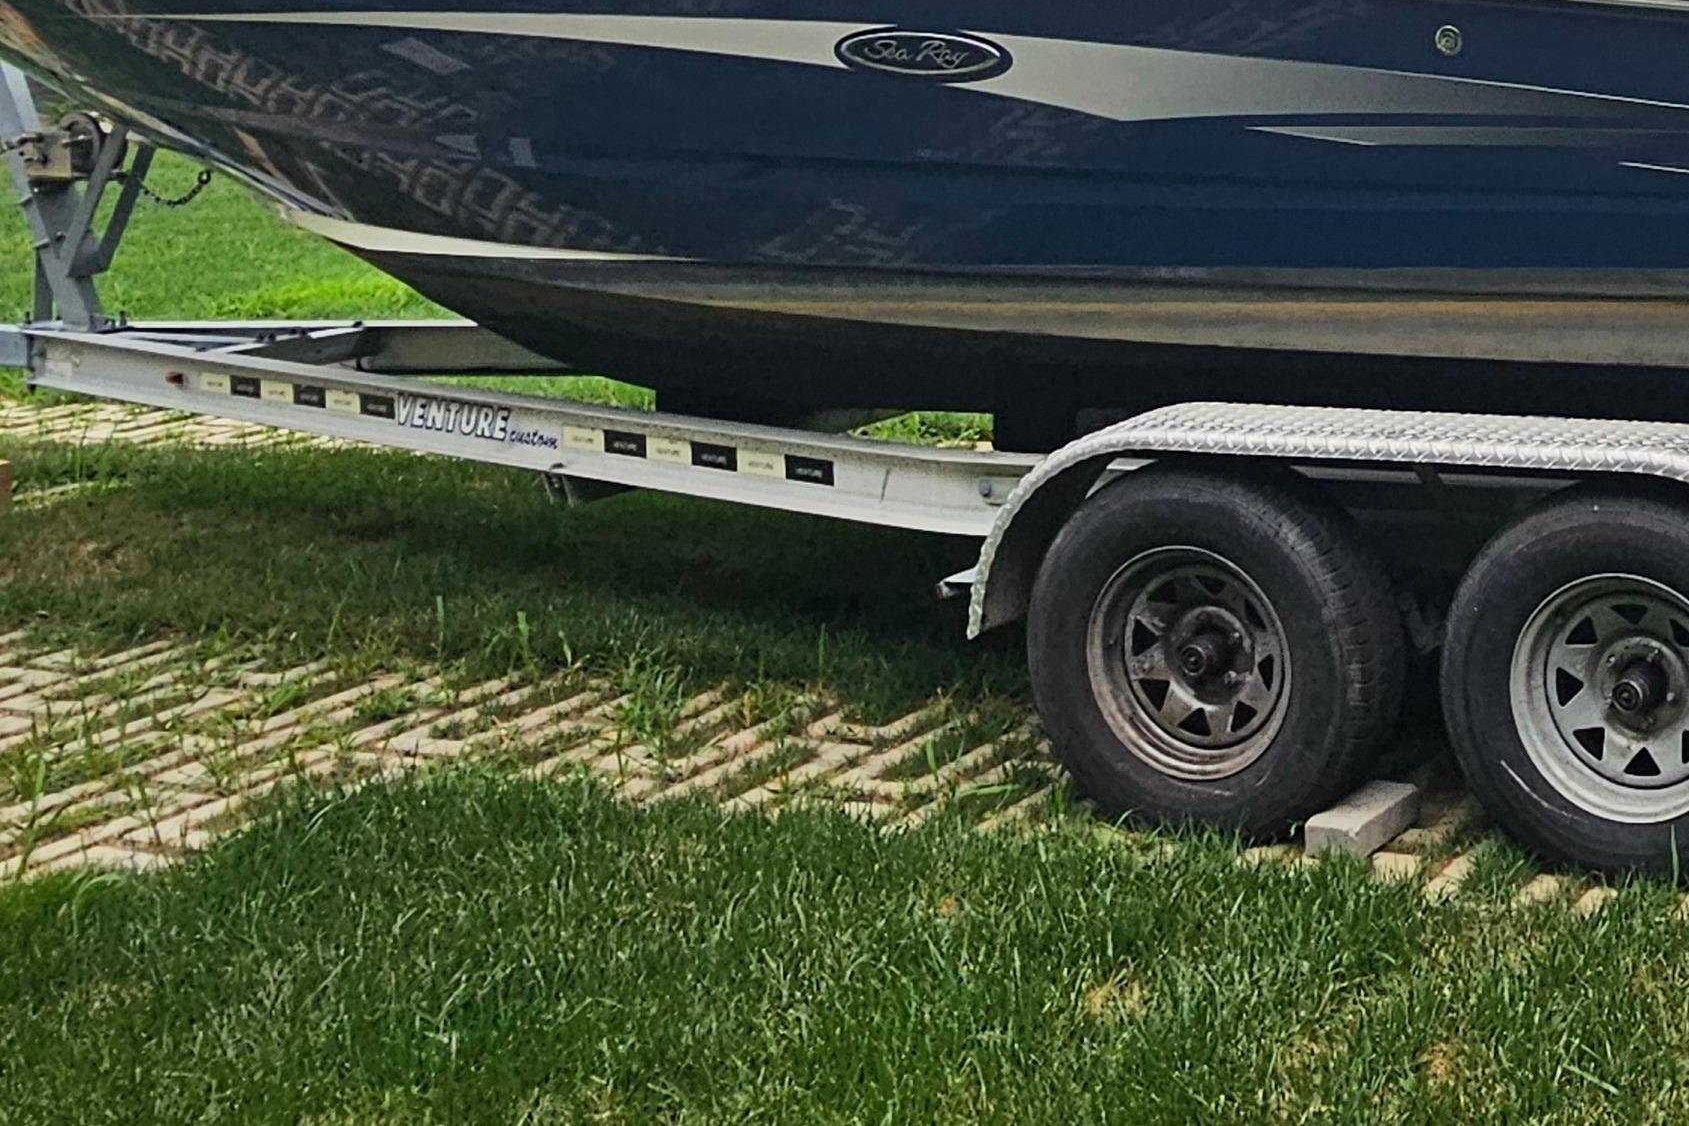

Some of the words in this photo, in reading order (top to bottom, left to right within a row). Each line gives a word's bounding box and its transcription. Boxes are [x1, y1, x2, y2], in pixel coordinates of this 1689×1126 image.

[864, 39, 913, 60] Sea
[915, 40, 969, 69] Ray
[396, 395, 511, 441] VENTURE
[510, 429, 559, 450] custom
